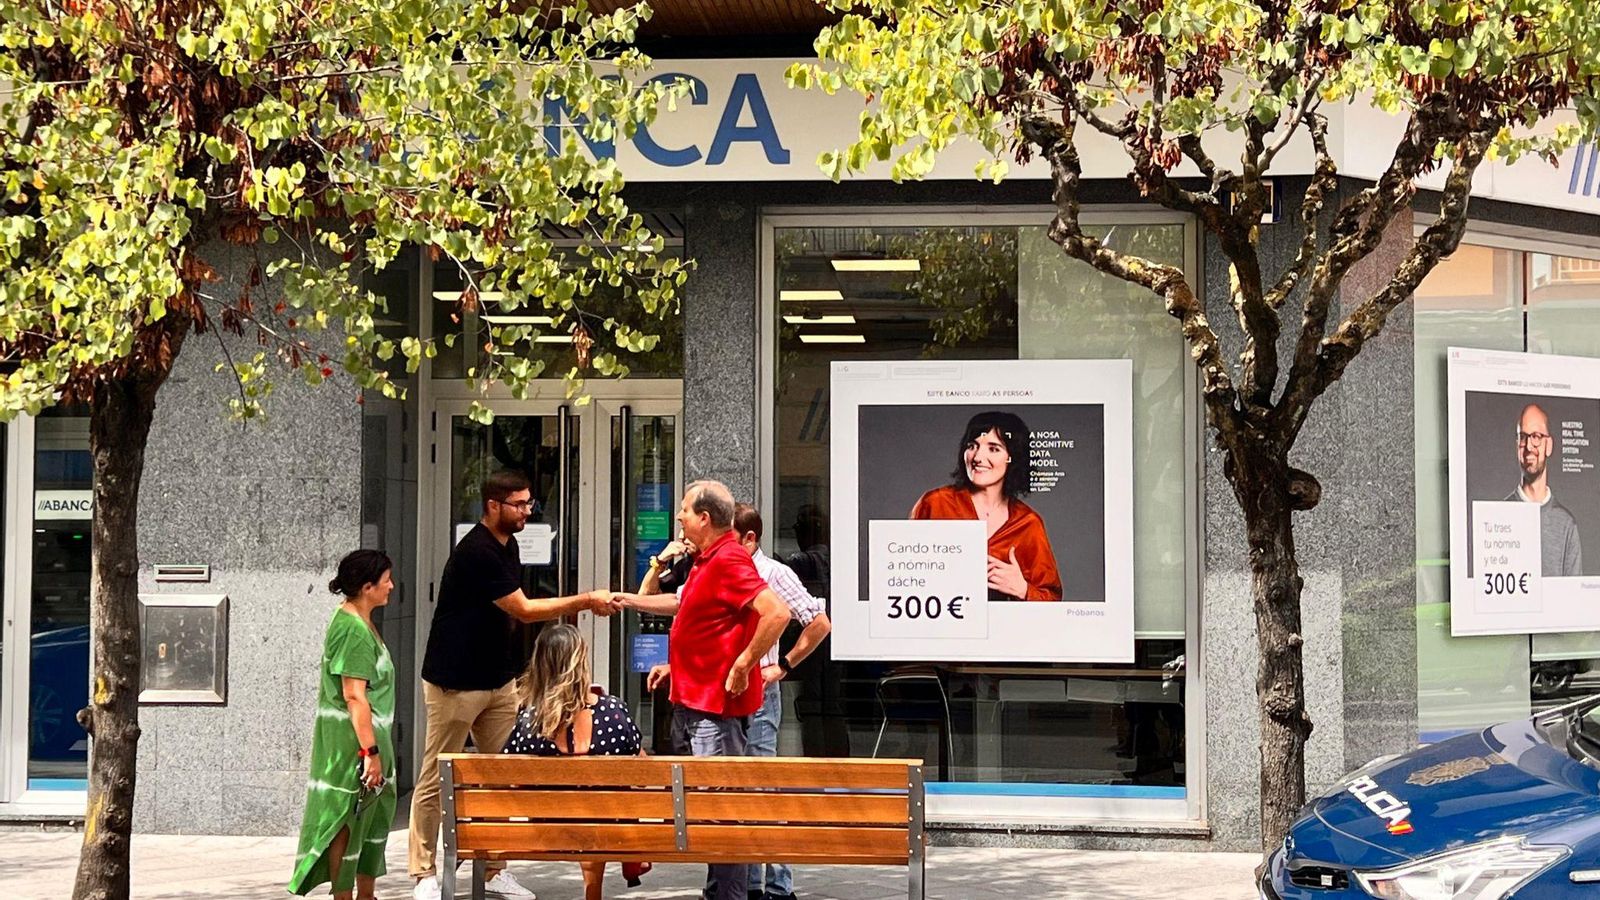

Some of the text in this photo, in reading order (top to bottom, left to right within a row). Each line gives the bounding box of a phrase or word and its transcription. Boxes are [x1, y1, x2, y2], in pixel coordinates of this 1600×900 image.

[1029, 431, 1060, 439] A NOSA
[1029, 440, 1075, 449] COGNITIVE
[1029, 450, 1051, 458] DATA
[1029, 459, 1059, 467] MODEL
[1494, 523, 1512, 533] traes
[887, 541, 963, 554] Cando traes
[1483, 540, 1491, 549] tu
[1490, 556, 1498, 565] te
[1499, 555, 1508, 565] da
[887, 561, 895, 570] a
